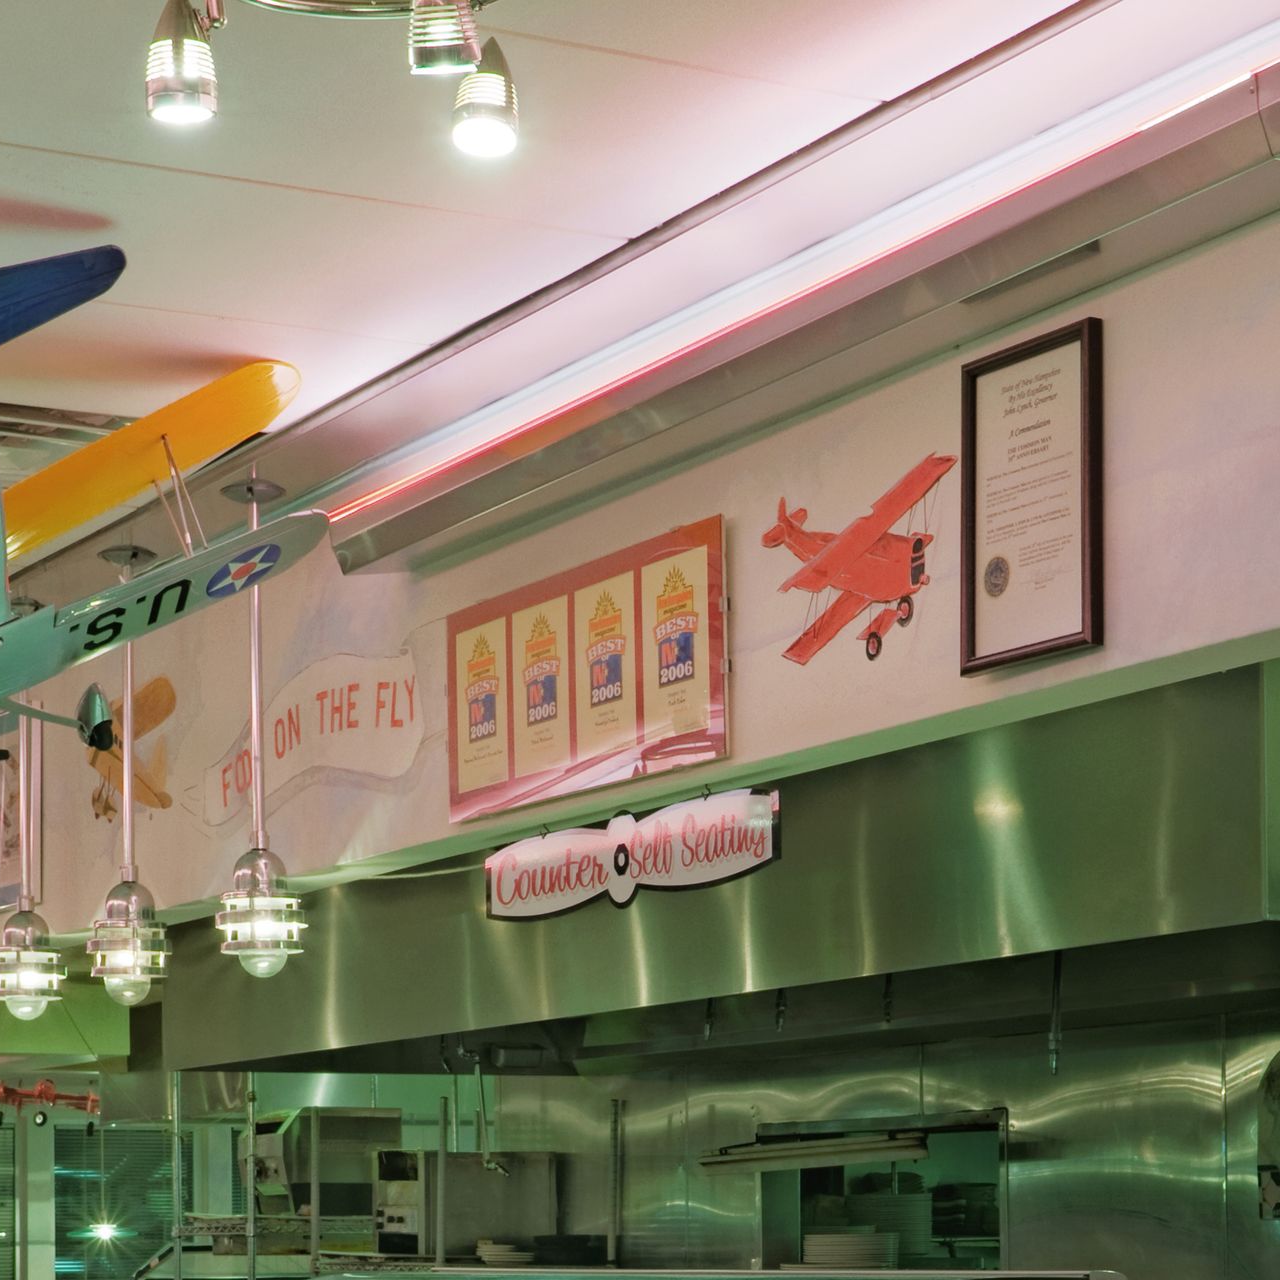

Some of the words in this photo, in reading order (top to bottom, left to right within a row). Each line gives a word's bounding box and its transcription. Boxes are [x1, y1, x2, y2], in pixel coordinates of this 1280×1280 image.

[655, 615, 697, 640] BEST
[587, 639, 625, 661] BEST
[524, 659, 560, 682] BEST
[660, 660, 693, 684] 2006
[466, 679, 498, 699] BEST
[591, 682, 622, 704] 2006
[528, 701, 556, 723] 2006
[469, 719, 496, 740] 2006
[222, 748, 253, 808] FOO
[273, 704, 302, 760] ON
[315, 682, 360, 735] THE
[375, 674, 416, 728] FLY
[495, 847, 609, 906] Counter
[629, 819, 672, 879] Self
[680, 813, 769, 867] Seating
